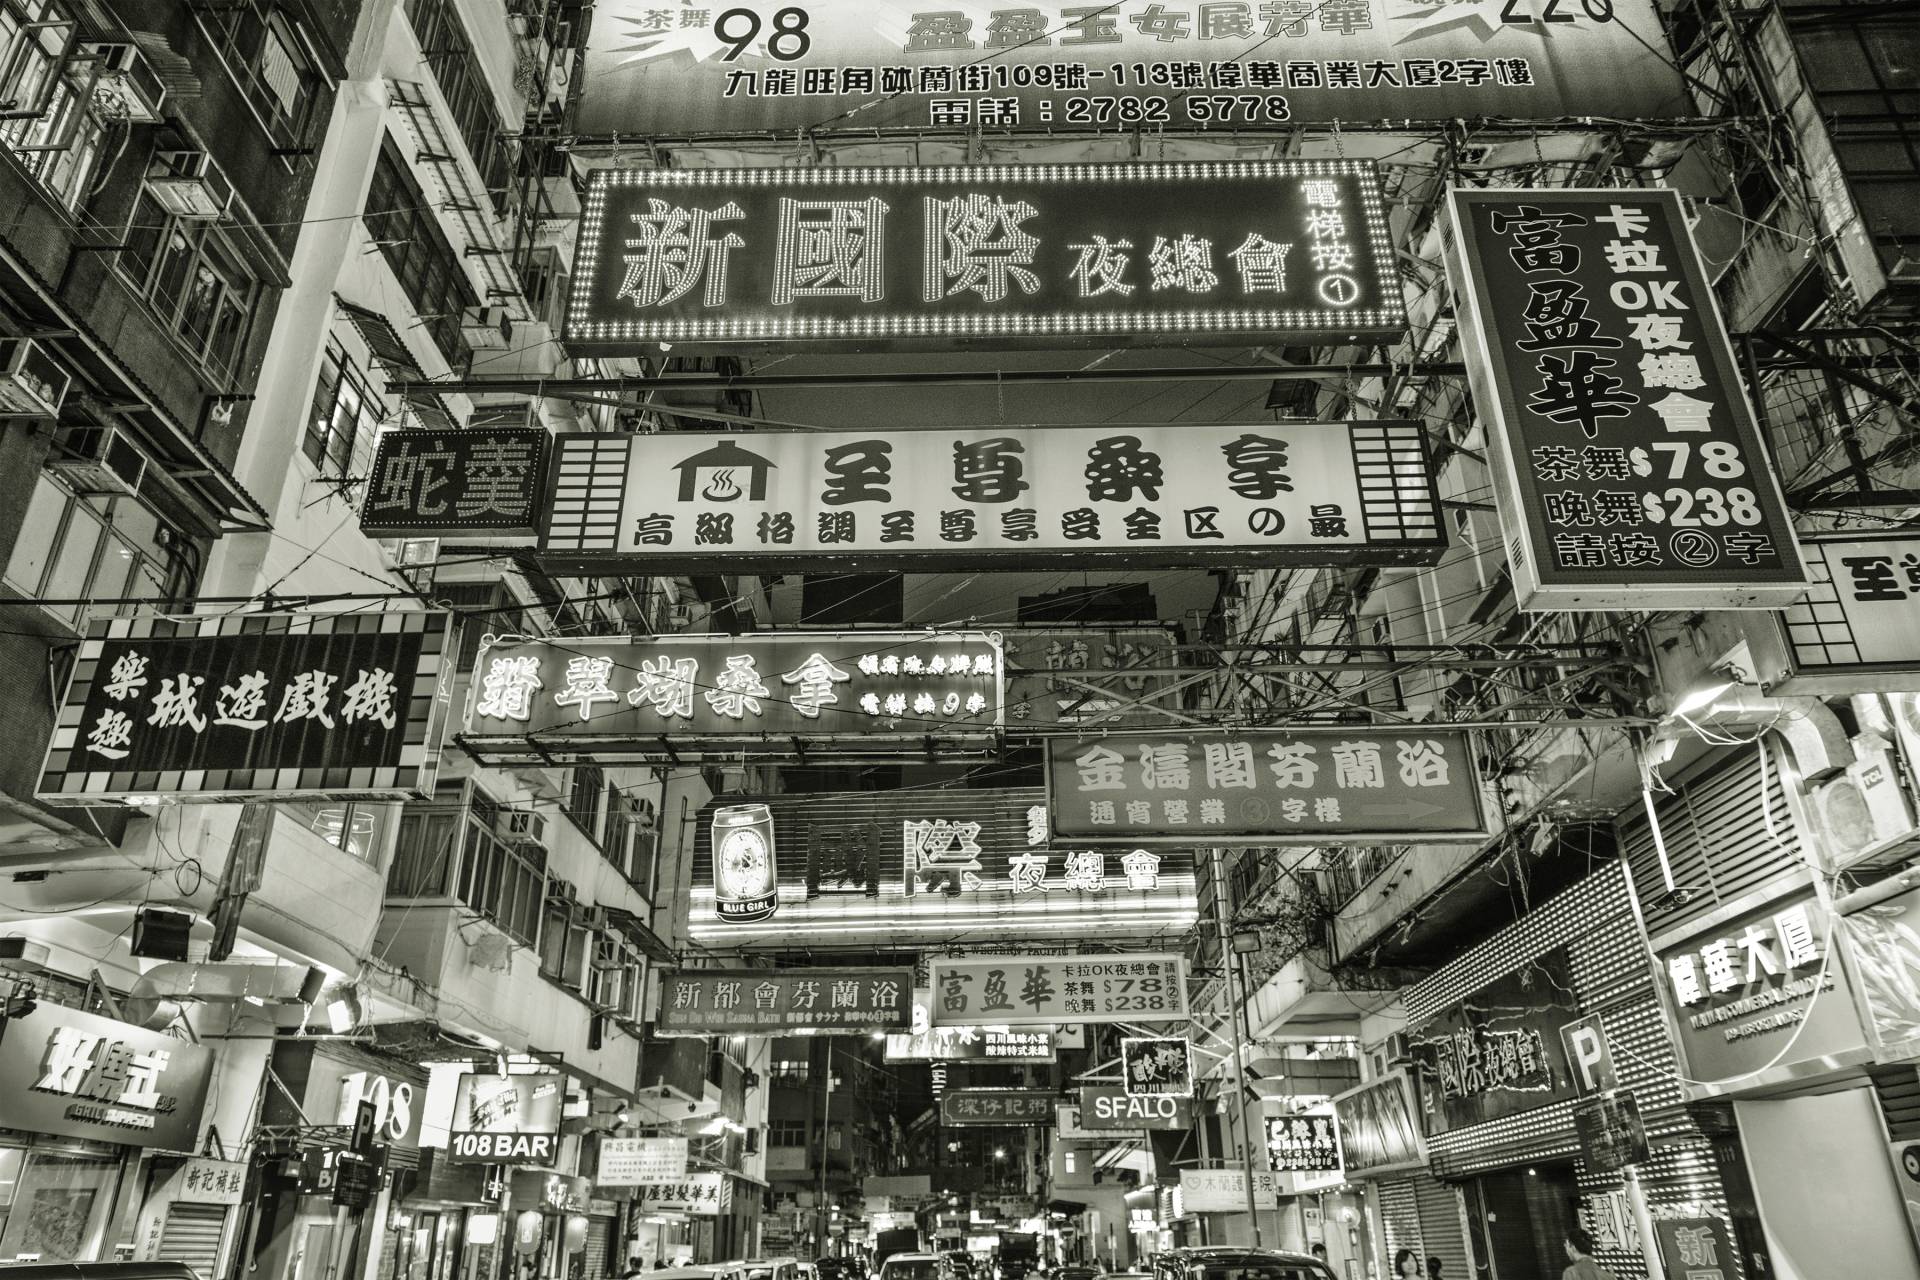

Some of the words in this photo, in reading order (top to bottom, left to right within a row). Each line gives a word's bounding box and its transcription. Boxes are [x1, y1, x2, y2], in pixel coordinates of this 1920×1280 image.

[642, 9, 711, 29] 茶舞
[713, 7, 811, 62] 98
[904, 0, 1373, 53] 盈盈玉女展芳華
[1066, 97, 1170, 123] 2782
[1186, 95, 1291, 122] 5778
[1492, 206, 1640, 439] 富盈華
[1842, 553, 1920, 602] 至
[1076, 739, 1450, 791] 金濤閣芬蘭浴
[1863, 769, 1883, 787] TCL
[723, 902, 746, 913] BLUE
[747, 900, 770, 912] GIRL
[672, 980, 900, 1010] 新都會芬蘭浴
[939, 965, 1057, 1014] 富盈華
[1571, 1027, 1602, 1090] P
[337, 1071, 413, 1140] 108
[353, 1106, 373, 1149] P
[1095, 1096, 1177, 1119] SFALO
[453, 1134, 492, 1156] 108
[494, 1135, 549, 1157] BAR
